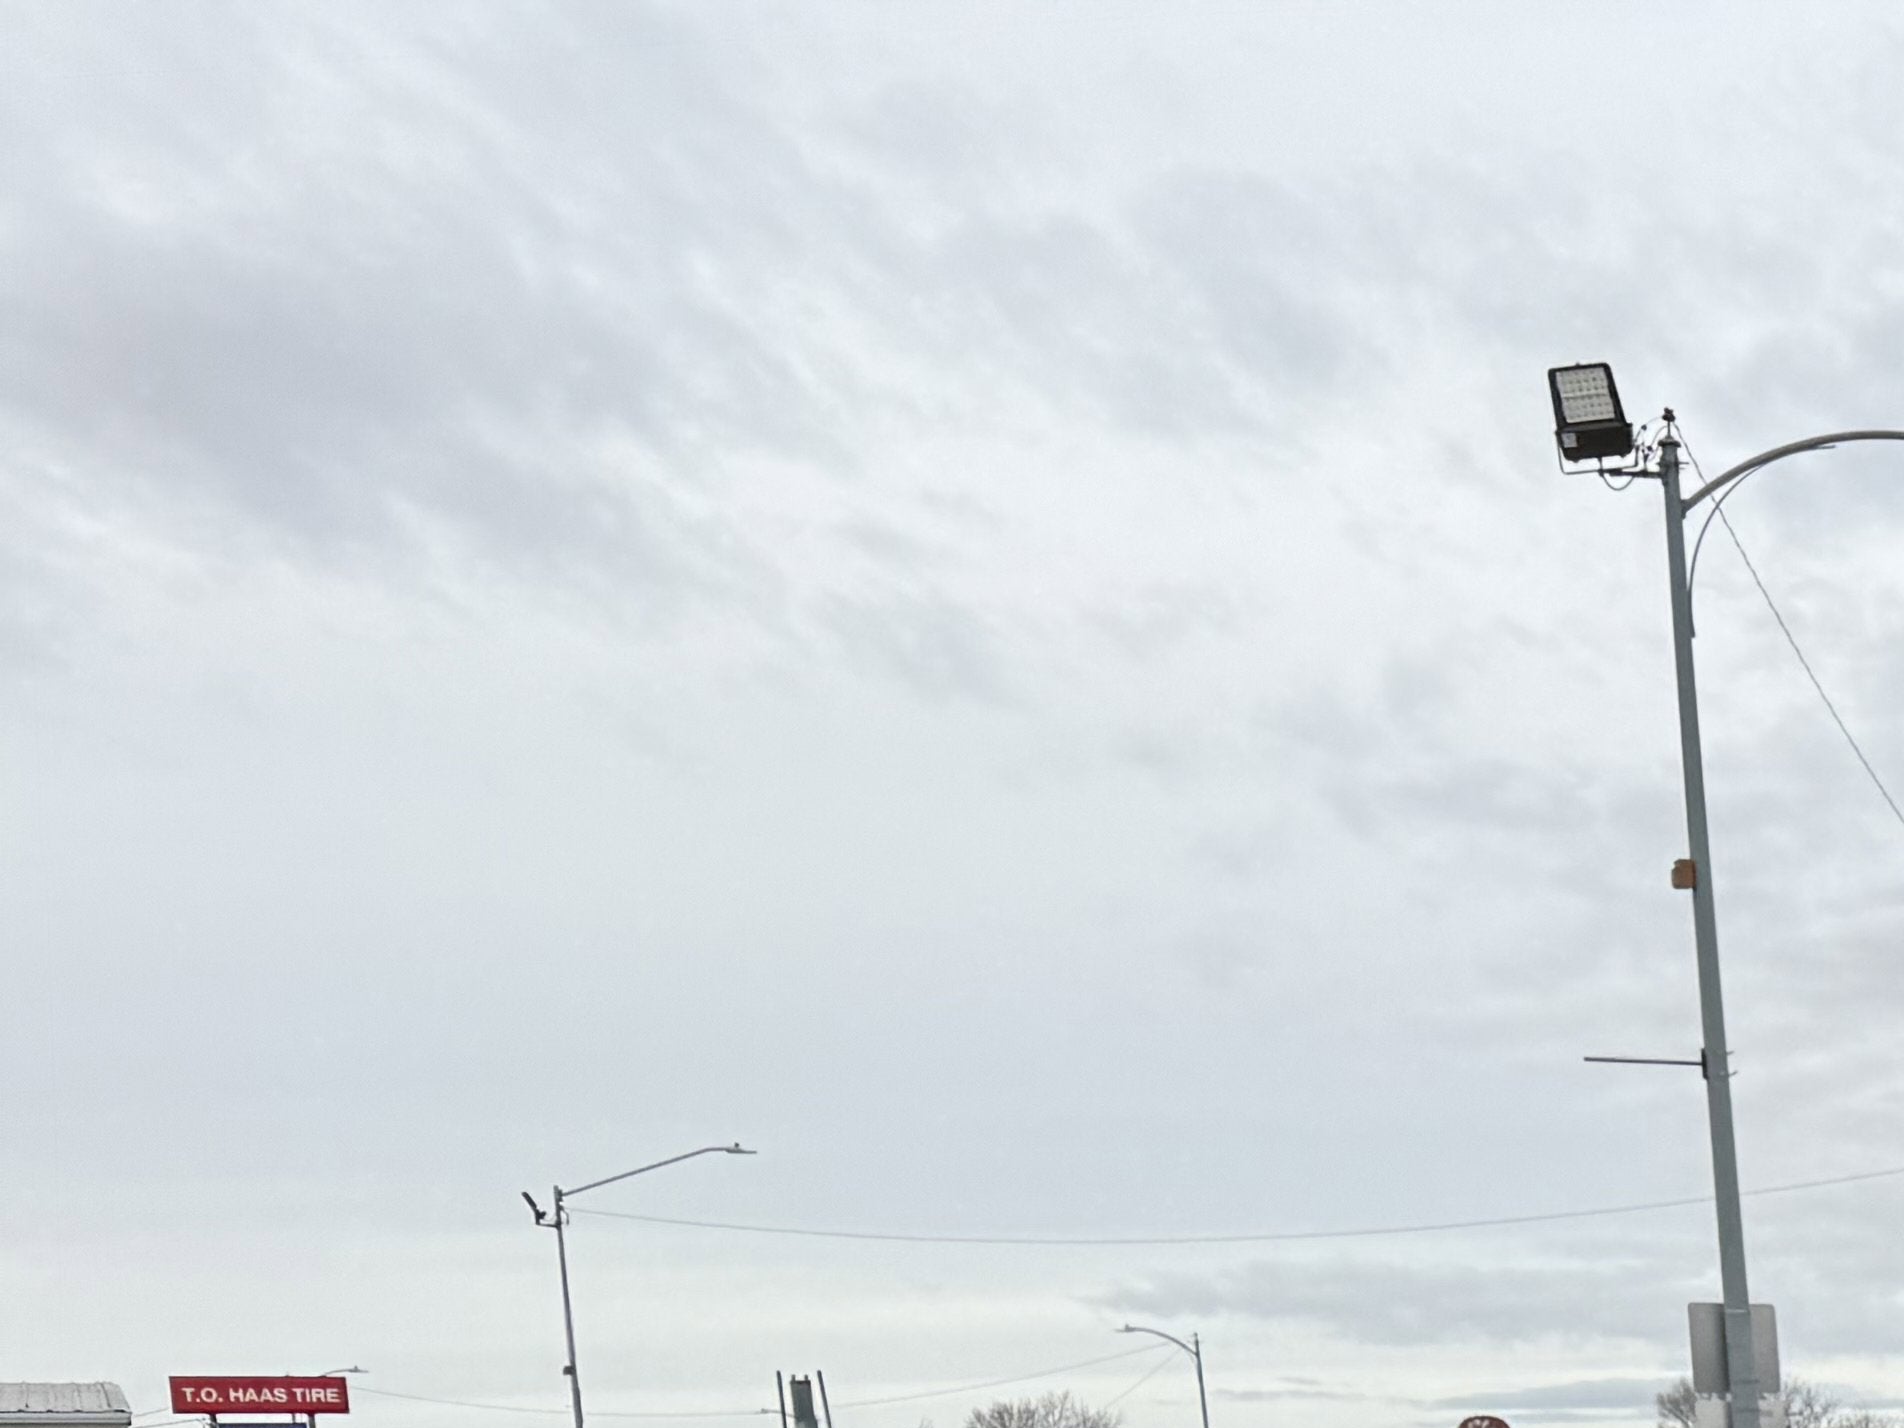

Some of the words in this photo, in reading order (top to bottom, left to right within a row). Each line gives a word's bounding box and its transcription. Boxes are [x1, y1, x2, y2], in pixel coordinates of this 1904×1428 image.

[181, 1387, 223, 1403] T.O.
[228, 1387, 287, 1403] HAAS
[291, 1387, 340, 1403] TIRE
